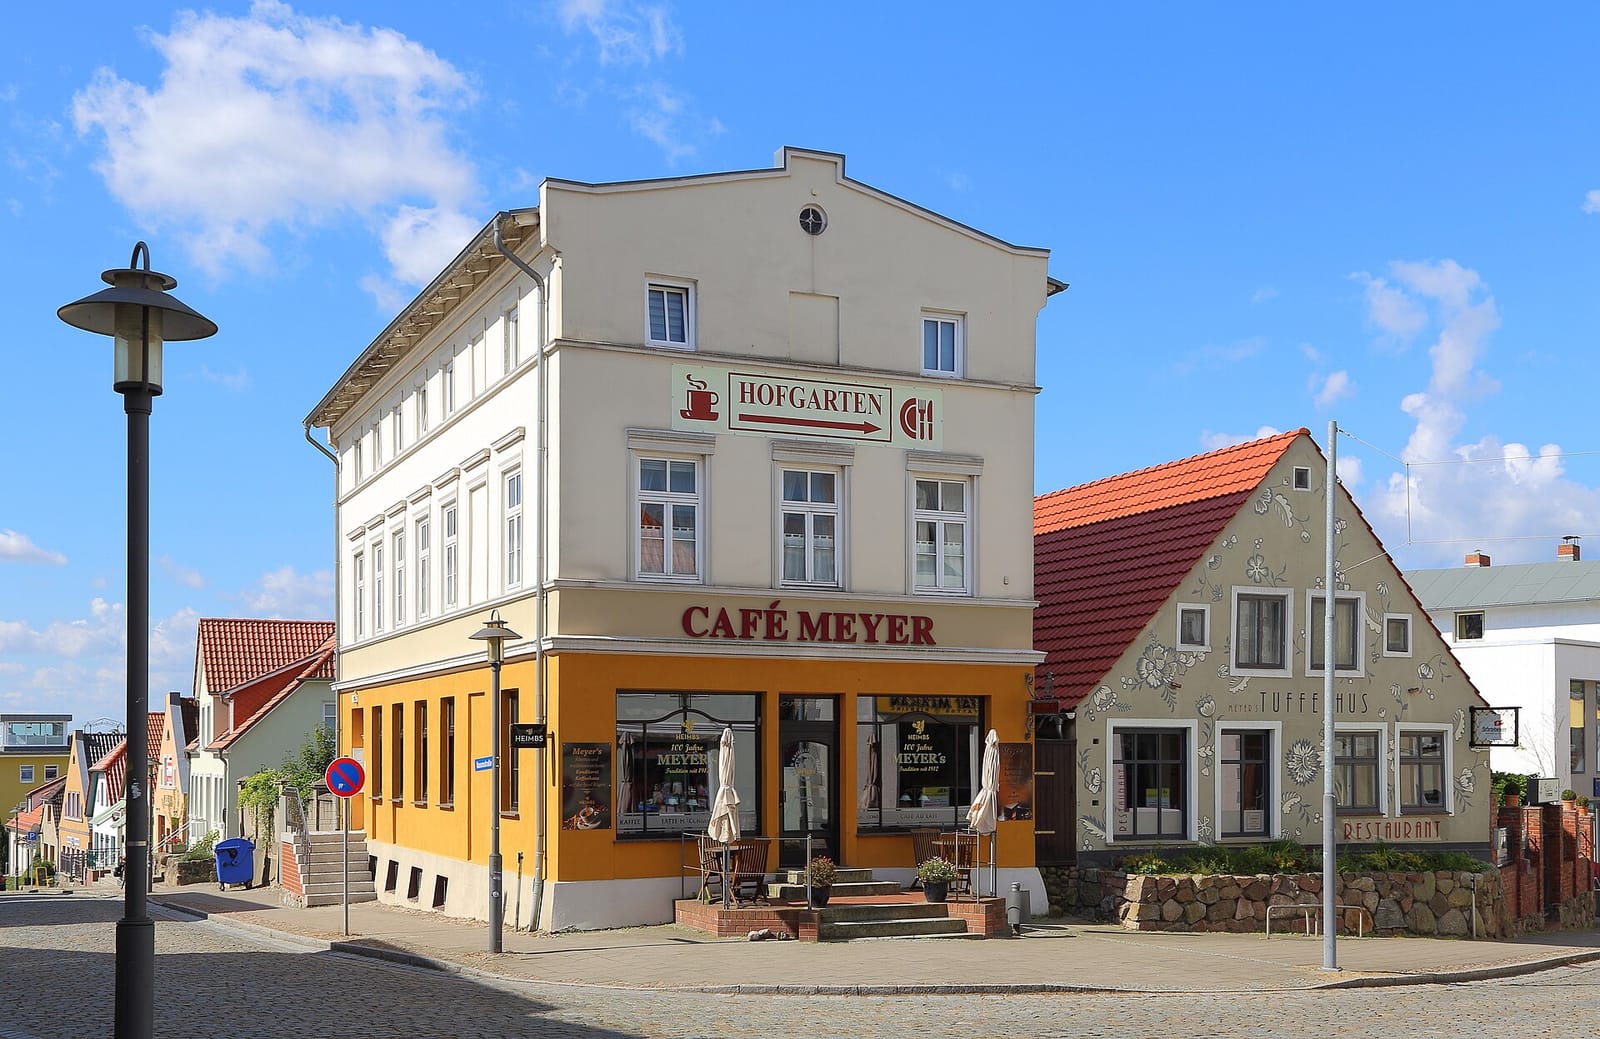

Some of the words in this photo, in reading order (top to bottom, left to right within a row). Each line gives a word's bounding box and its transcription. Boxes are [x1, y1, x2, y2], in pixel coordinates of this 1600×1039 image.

[739, 381, 883, 416] HOFGARTEN
[682, 600, 789, 640] CAFÉ
[797, 611, 937, 646] MEYER
[1260, 692, 1368, 714] TUFFEHUS
[572, 747, 603, 757] Meyer's
[671, 743, 684, 752] 100
[685, 743, 704, 753] Jahre
[903, 743, 916, 751] 100
[916, 743, 933, 752] Jahre
[1343, 821, 1441, 840] RESTAURANT
